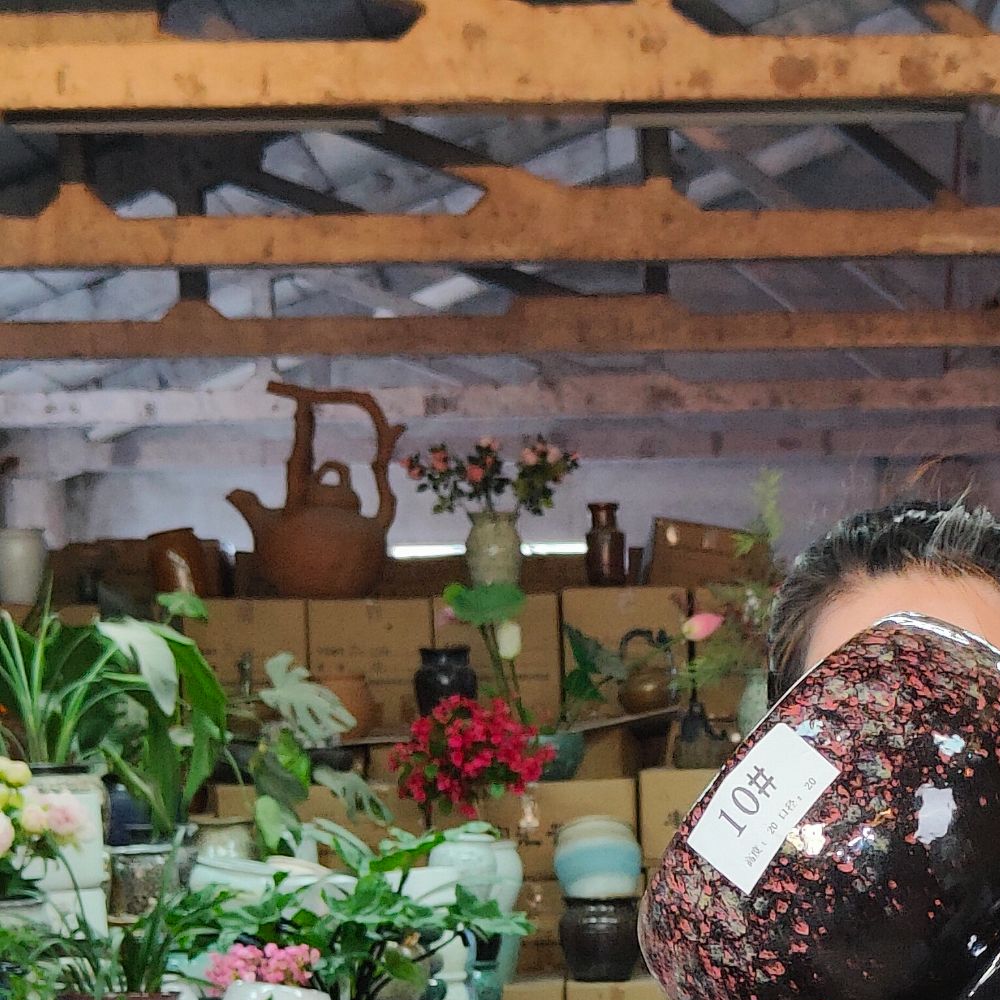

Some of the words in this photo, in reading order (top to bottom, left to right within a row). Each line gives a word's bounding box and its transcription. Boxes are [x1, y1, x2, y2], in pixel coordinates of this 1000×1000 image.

[719, 765, 777, 838] 10#
[767, 822, 779, 835] 20
[804, 777, 817, 791] 20
